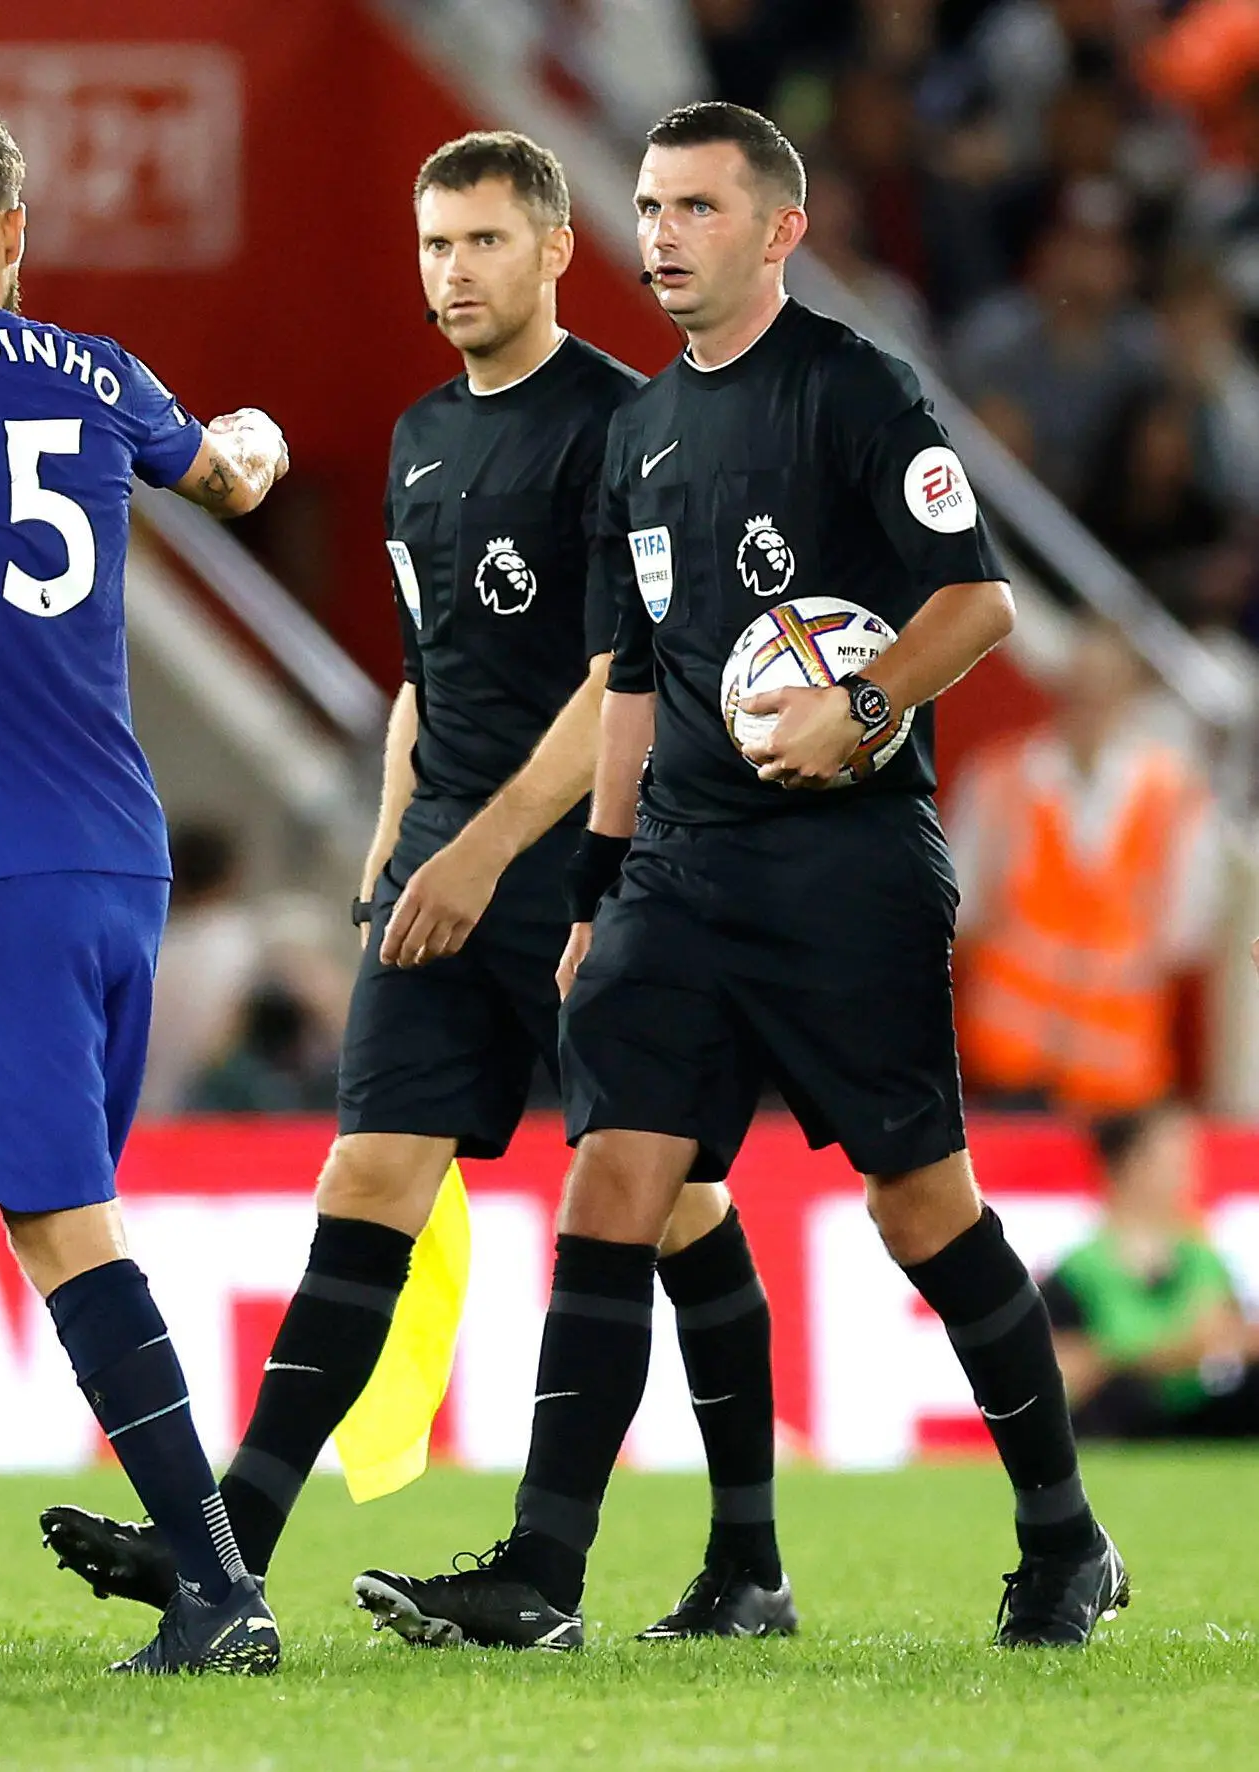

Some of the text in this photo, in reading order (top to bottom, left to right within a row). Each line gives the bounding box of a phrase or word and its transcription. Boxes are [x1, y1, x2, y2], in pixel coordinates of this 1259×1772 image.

[2, 418, 96, 618] 5
[634, 534, 666, 558] FIFA
[640, 569, 669, 584] REFEREE
[837, 646, 867, 656] NIKE
